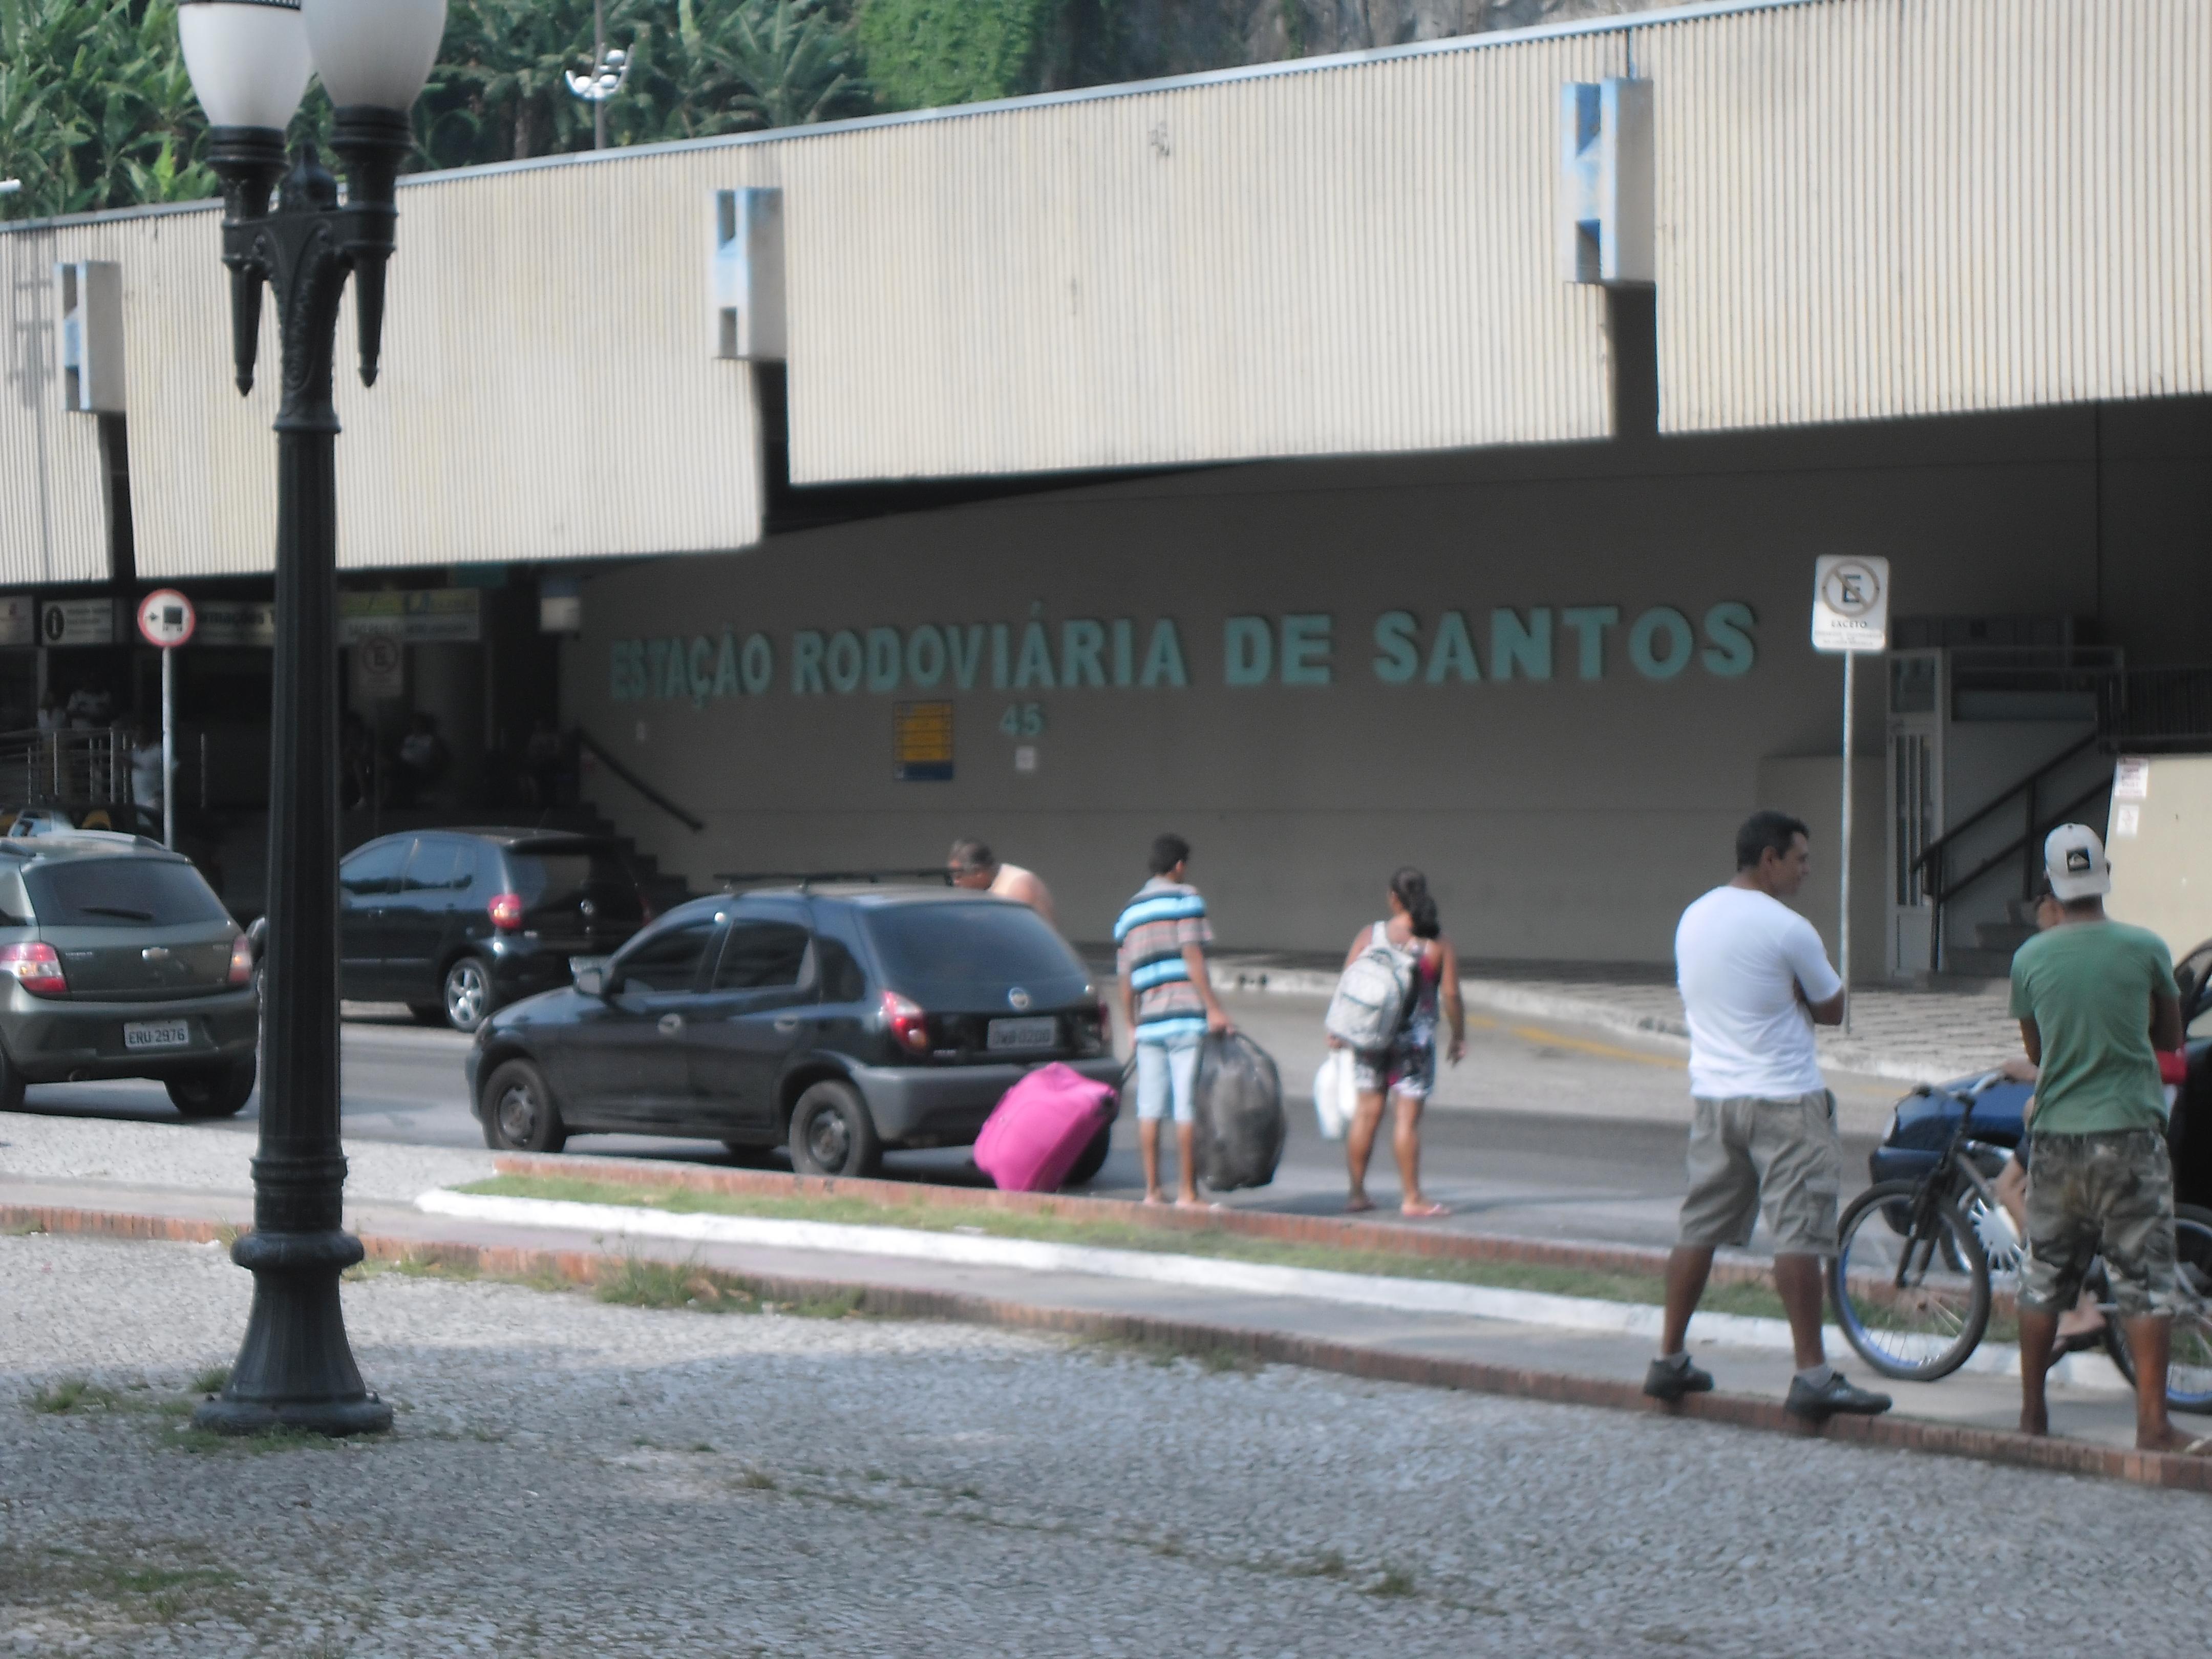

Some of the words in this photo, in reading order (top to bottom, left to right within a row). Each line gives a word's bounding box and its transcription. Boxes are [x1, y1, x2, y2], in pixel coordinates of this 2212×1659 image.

[1831, 619, 1868, 629] EXCETO
[609, 623, 772, 710] ESTAÇÃO
[792, 601, 1189, 694] RODOVIÁRIA
[1224, 613, 1332, 687] DE
[1373, 601, 1757, 686] SANTOS
[999, 701, 1047, 737] 45
[128, 1031, 152, 1045] ERU
[155, 1028, 186, 1043] 2976
